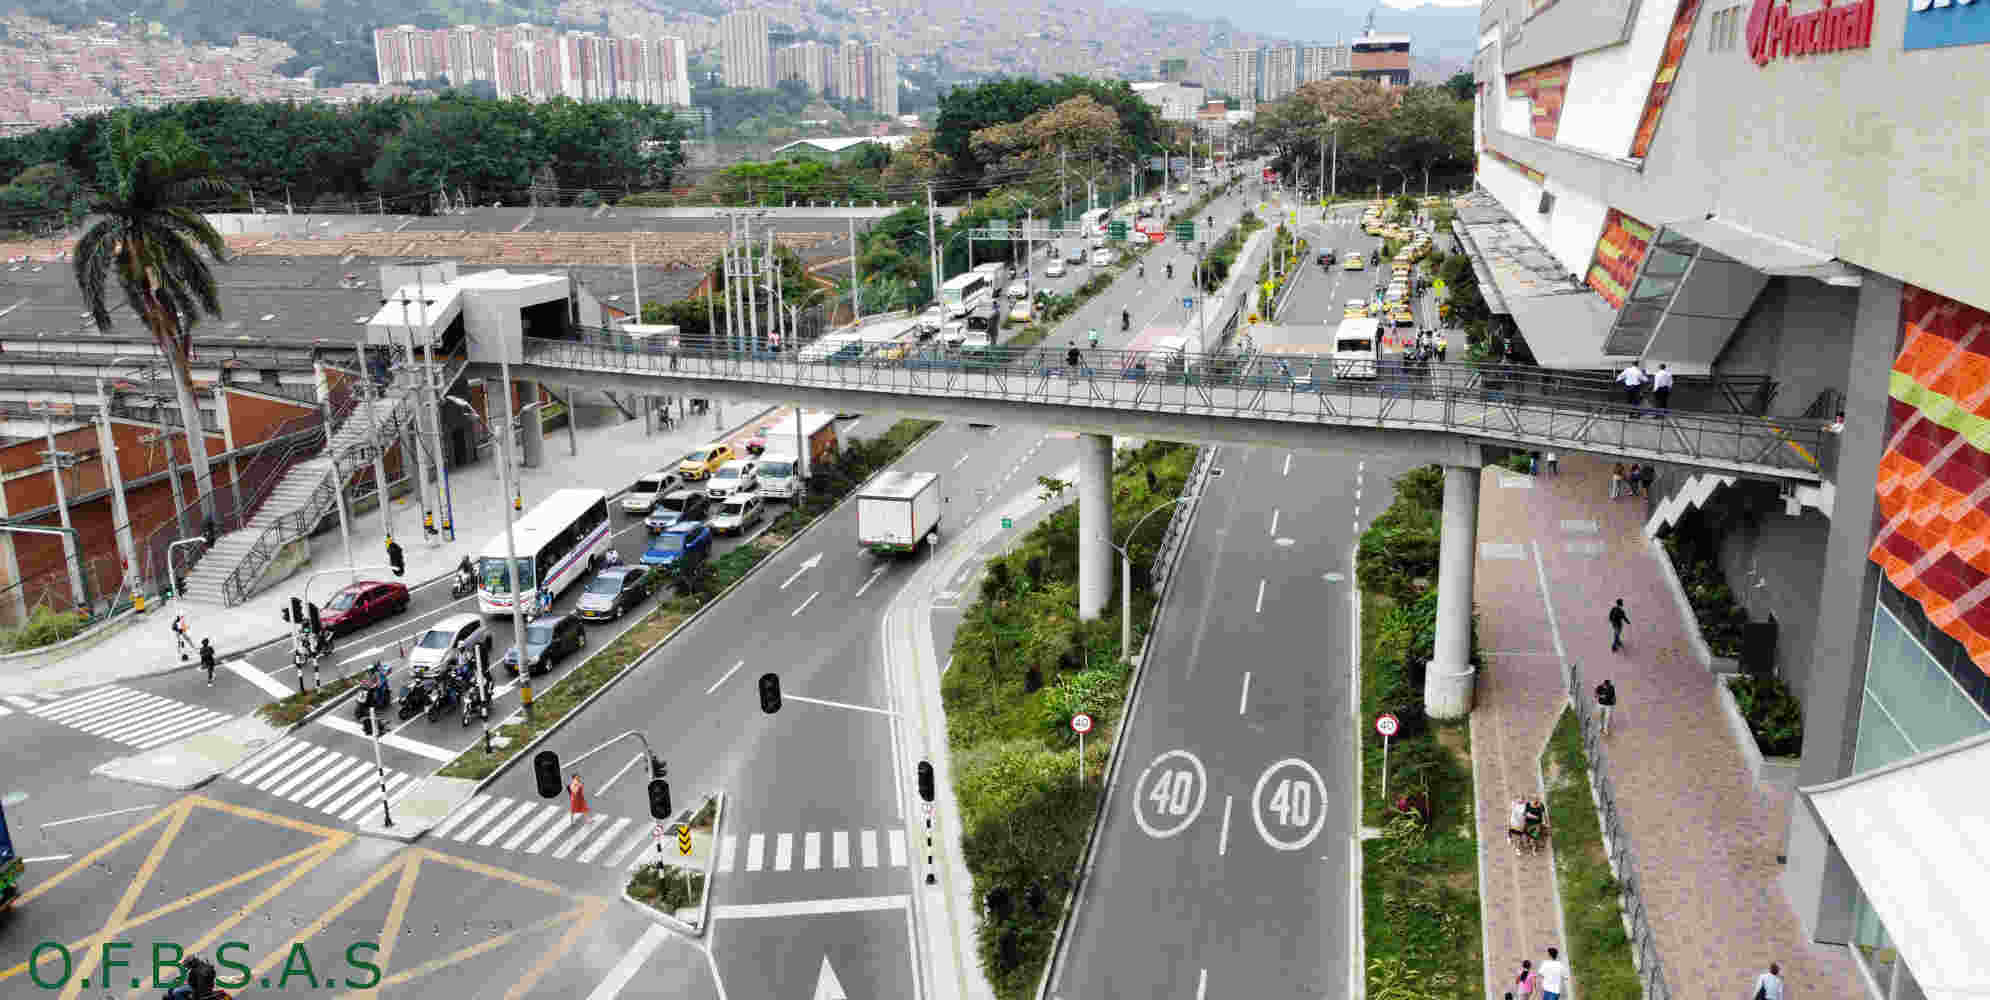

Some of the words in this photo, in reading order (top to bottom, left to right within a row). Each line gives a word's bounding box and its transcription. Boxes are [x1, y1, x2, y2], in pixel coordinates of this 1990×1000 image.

[1074, 717, 1089, 729] 40
[1379, 719, 1394, 730] 40
[1150, 769, 1193, 815] 40
[1268, 778, 1311, 826] 40
